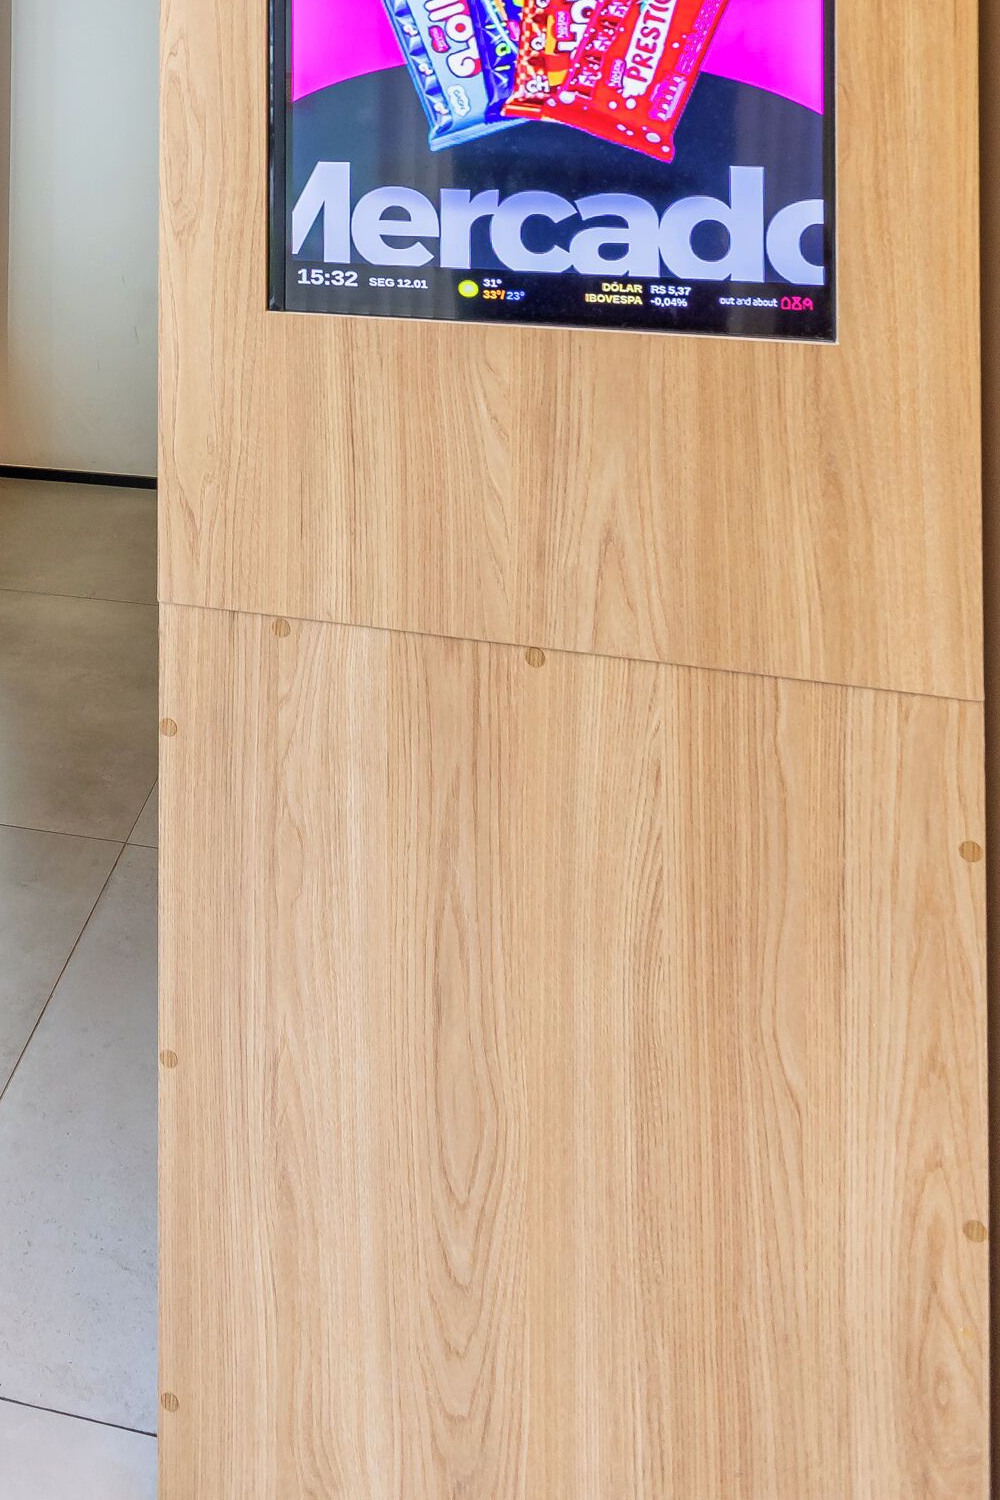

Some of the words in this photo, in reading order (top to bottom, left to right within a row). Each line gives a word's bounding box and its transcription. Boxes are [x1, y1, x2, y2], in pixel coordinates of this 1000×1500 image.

[297, 268, 359, 287] 15:32
[368, 277, 395, 288] SEG
[397, 278, 429, 290] 12.01
[602, 281, 643, 293] DÓLAR
[668, 286, 692, 296] 5,37
[585, 293, 643, 305] IBOVESPA
[650, 297, 688, 307] -0,04%
[719, 296, 736, 306] out
[736, 297, 752, 306] and
[752, 297, 778, 308] about
